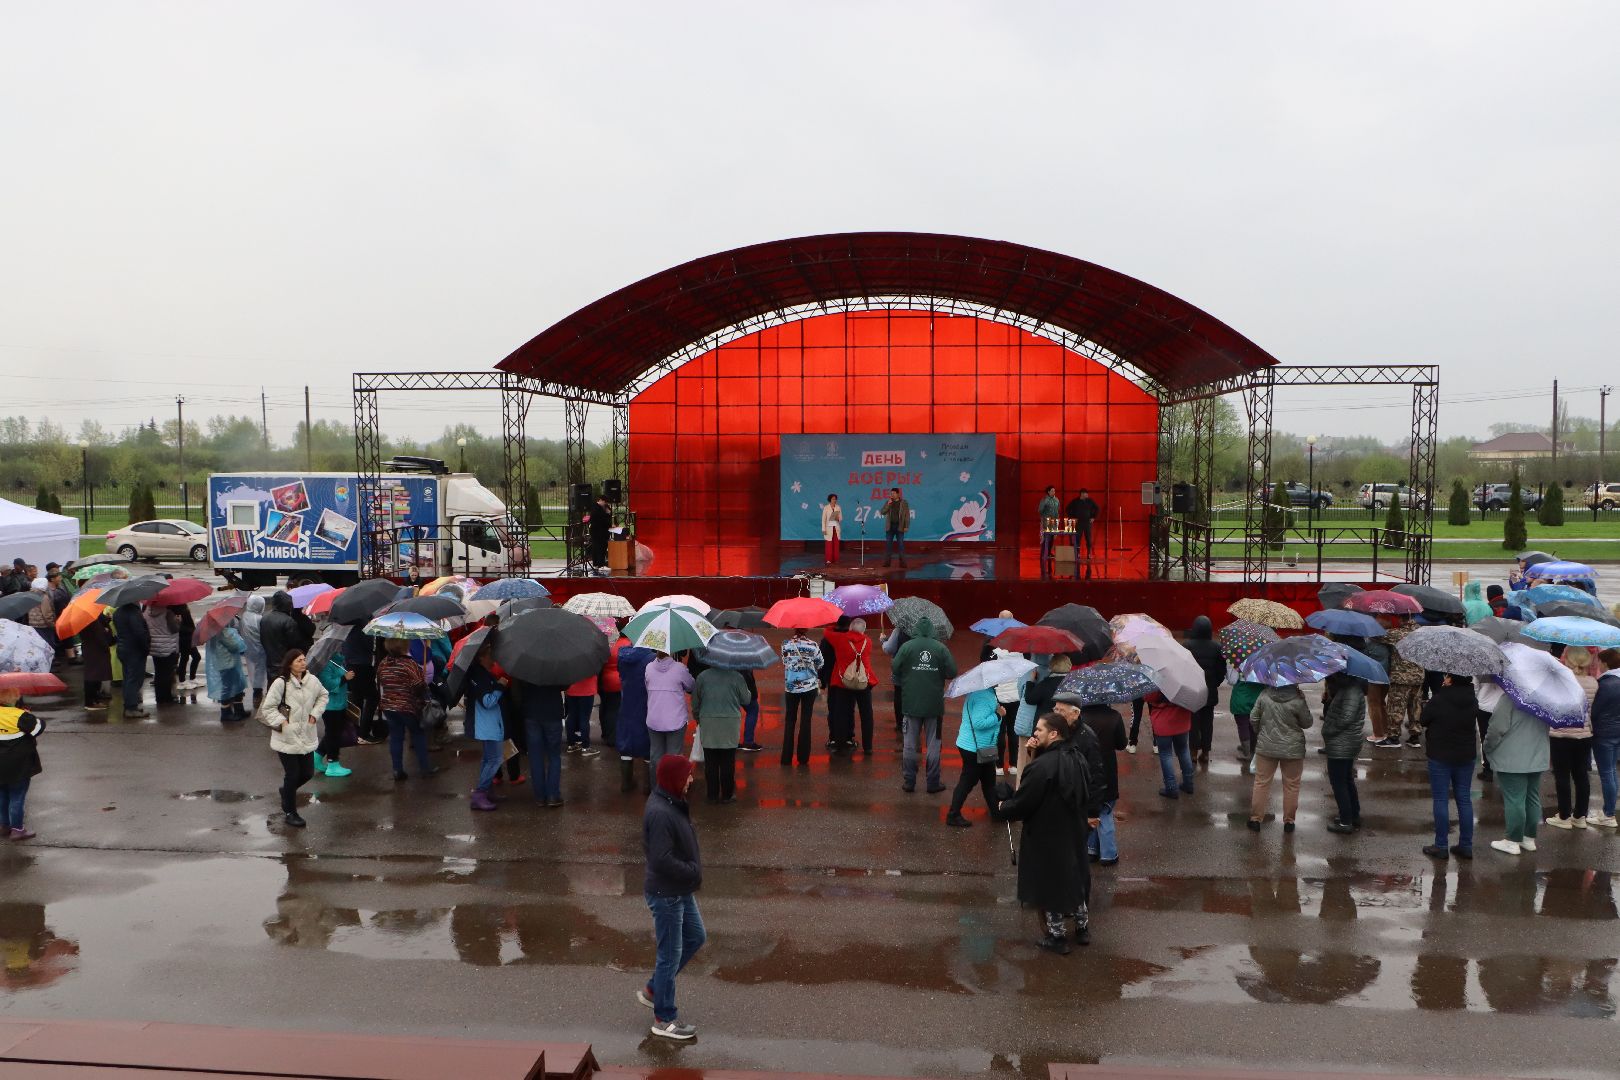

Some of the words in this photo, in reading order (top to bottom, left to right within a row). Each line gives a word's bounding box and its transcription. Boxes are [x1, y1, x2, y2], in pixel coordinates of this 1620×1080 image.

[864, 453, 903, 465] ДЕНЬ
[847, 471, 923, 486] ДОБРЫХ
[854, 505, 872, 522] 27
[266, 546, 298, 559] КИБО
